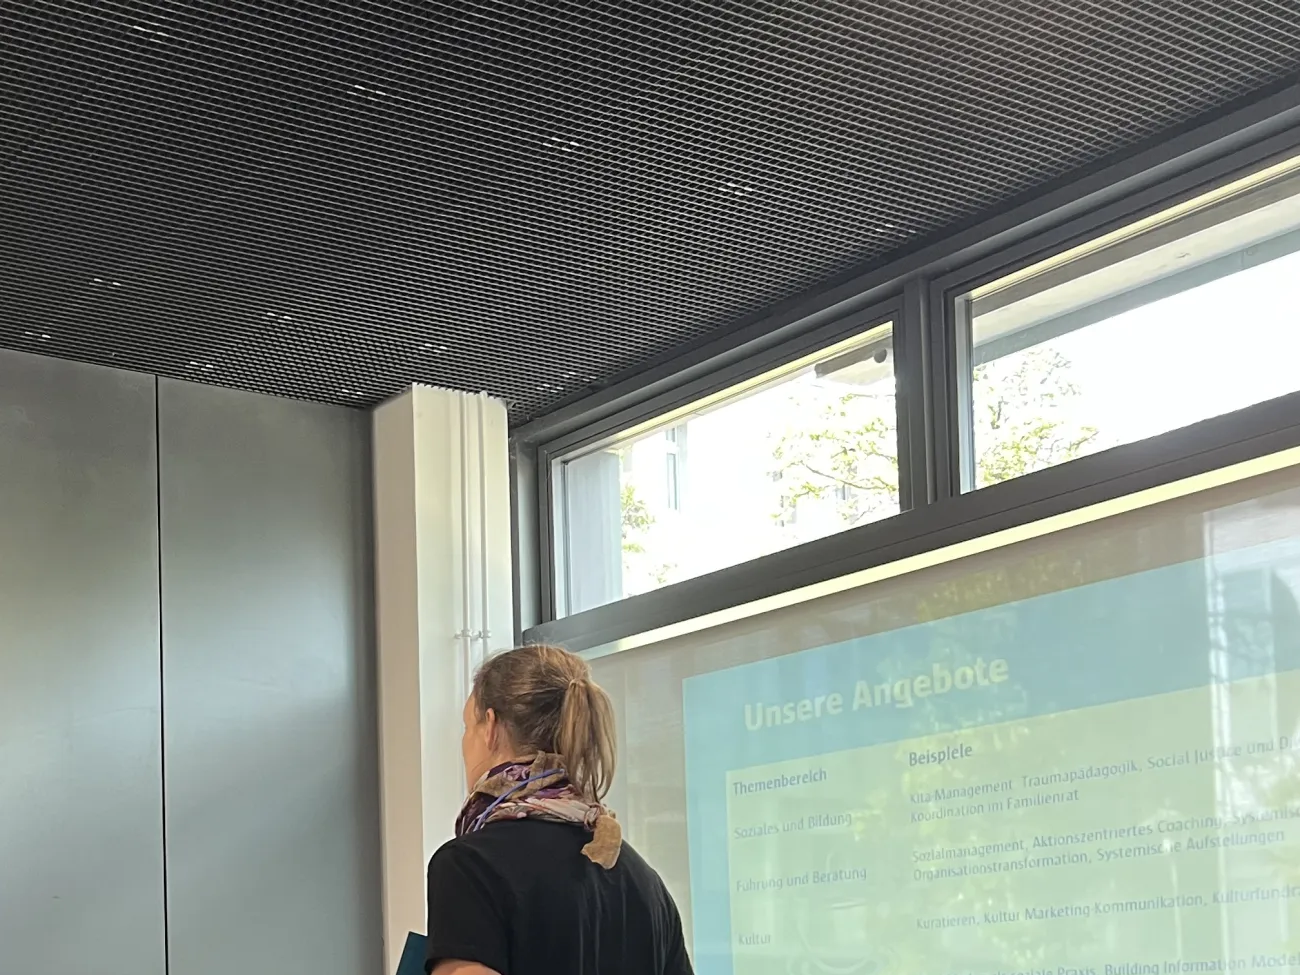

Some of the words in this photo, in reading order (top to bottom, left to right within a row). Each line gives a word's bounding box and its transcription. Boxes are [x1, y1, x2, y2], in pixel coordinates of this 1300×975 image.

[744, 691, 843, 731] Unsere
[852, 657, 1010, 711] Angebote
[909, 743, 973, 767] Beispiele
[1147, 752, 1190, 769] Social
[733, 768, 827, 797] Themenbereich
[910, 803, 984, 823] Koordination
[1007, 789, 1079, 810] Familienrat
[733, 823, 780, 839] Soziales
[782, 819, 804, 832] und
[807, 812, 852, 829] Bildung
[1033, 824, 1153, 848] Aktionszentriertes
[1186, 830, 1285, 851] Aufstellungen
[786, 874, 809, 887] und
[812, 868, 867, 884] Beratung
[738, 933, 772, 945] Kultur
